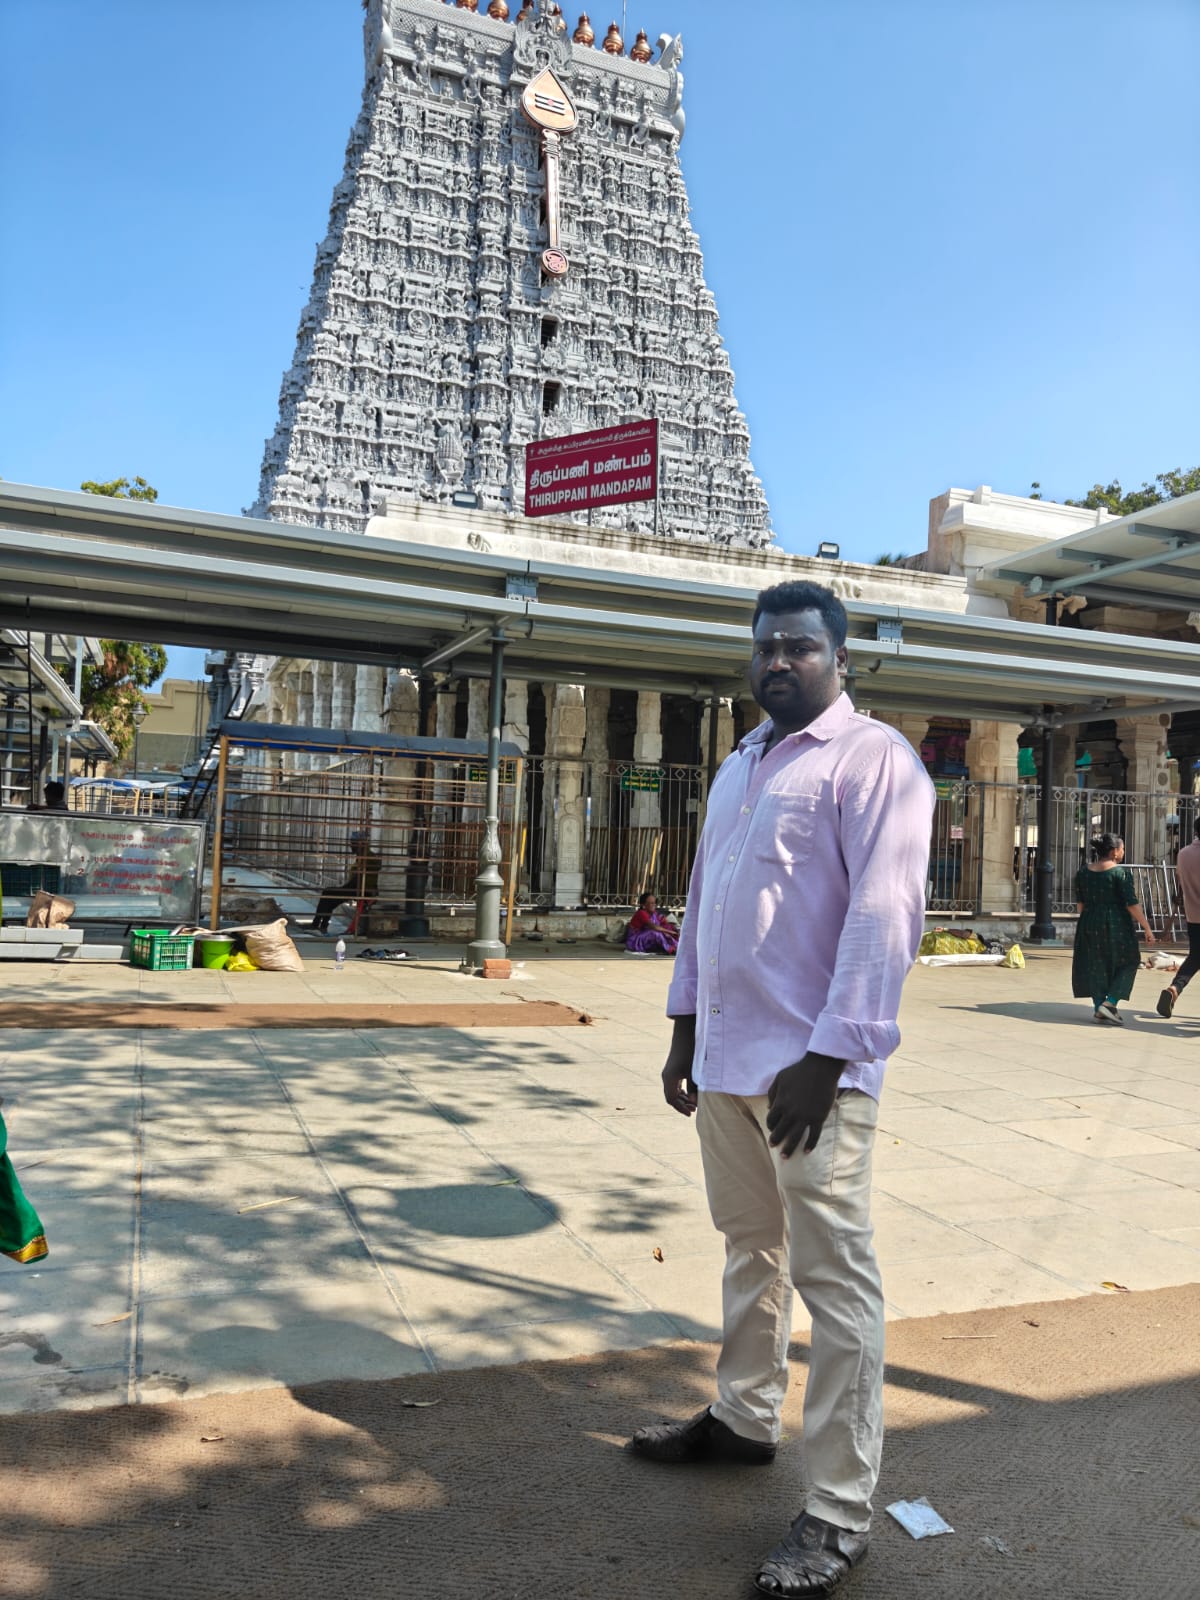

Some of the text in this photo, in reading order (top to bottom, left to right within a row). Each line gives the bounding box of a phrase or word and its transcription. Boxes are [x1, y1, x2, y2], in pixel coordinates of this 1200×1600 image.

[530, 448, 651, 490] திருப்பணி மண்டபம்
[529, 476, 651, 508] THIRUPPANI MANDAPAM
